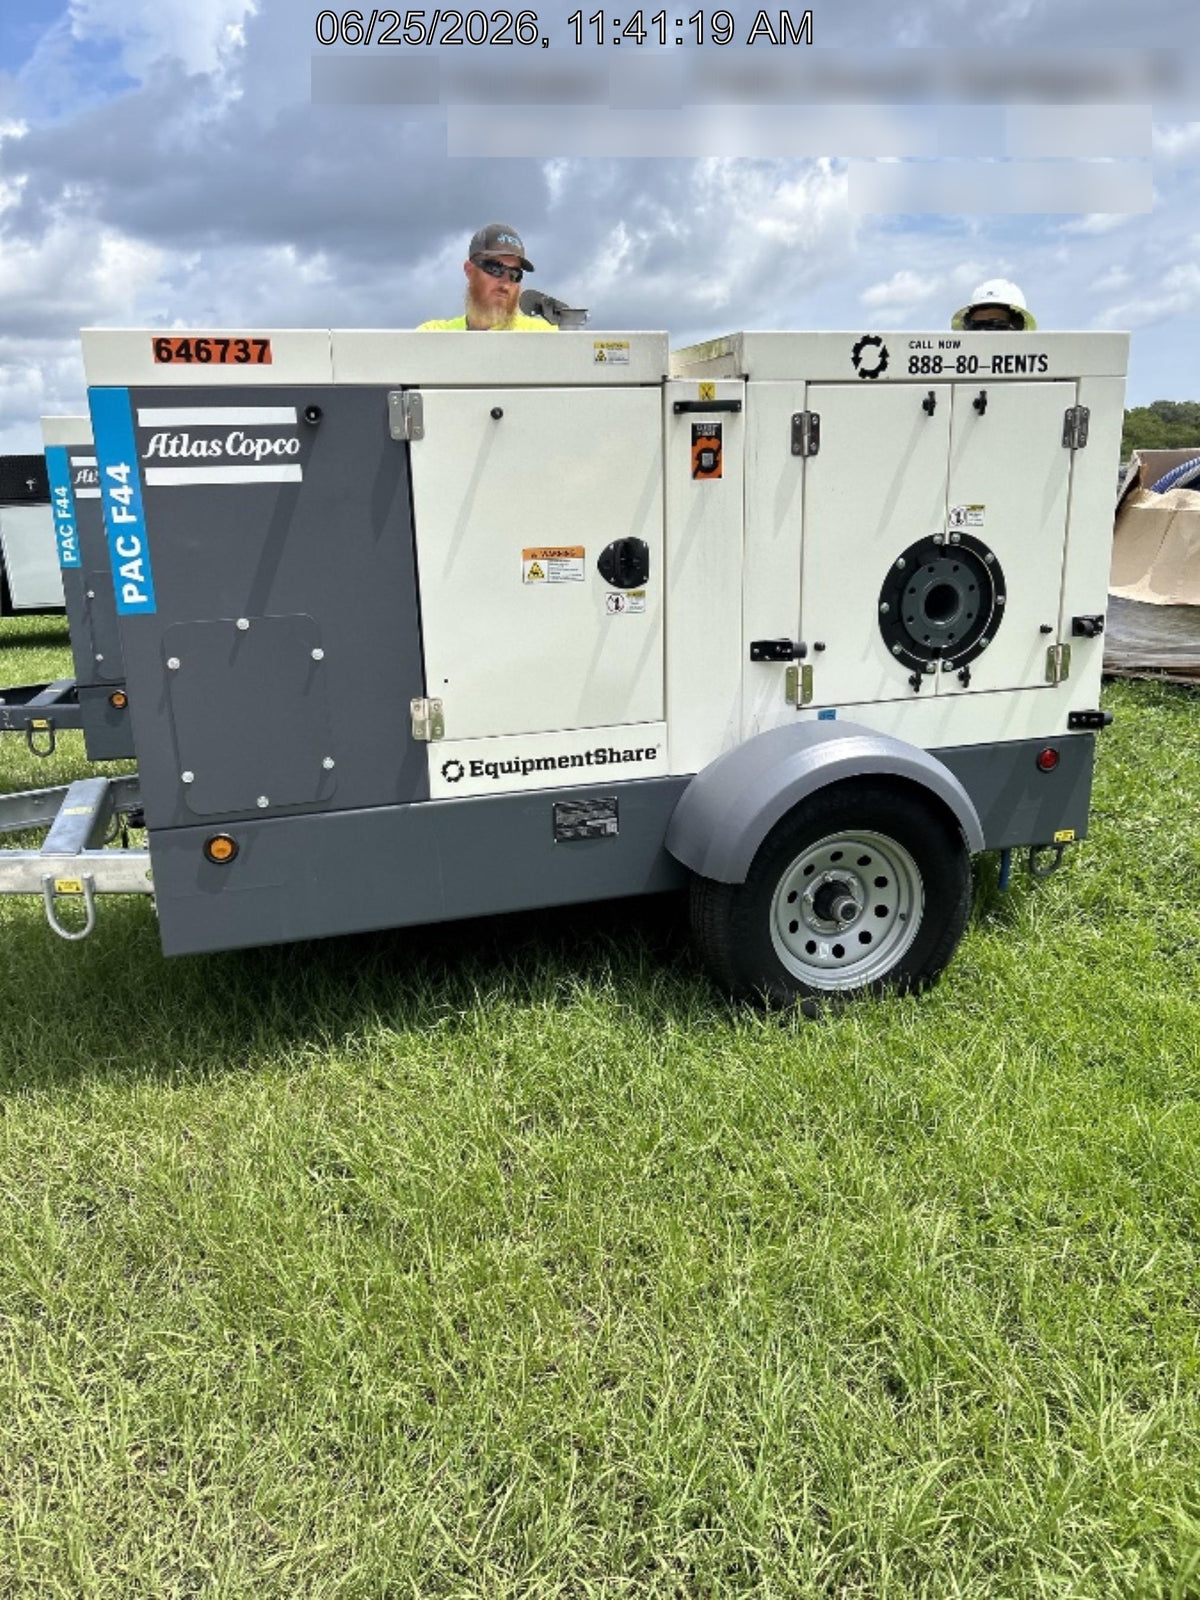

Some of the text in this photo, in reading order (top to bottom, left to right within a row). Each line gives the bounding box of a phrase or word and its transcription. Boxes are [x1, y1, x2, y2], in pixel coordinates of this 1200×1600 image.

[155, 338, 268, 363] 646737
[908, 340, 961, 350] CALL NOW
[142, 431, 301, 461] Atlas Copco
[54, 485, 78, 562] PAC F44
[105, 461, 148, 604] PAC F44
[469, 747, 658, 780] EquipmentShare
